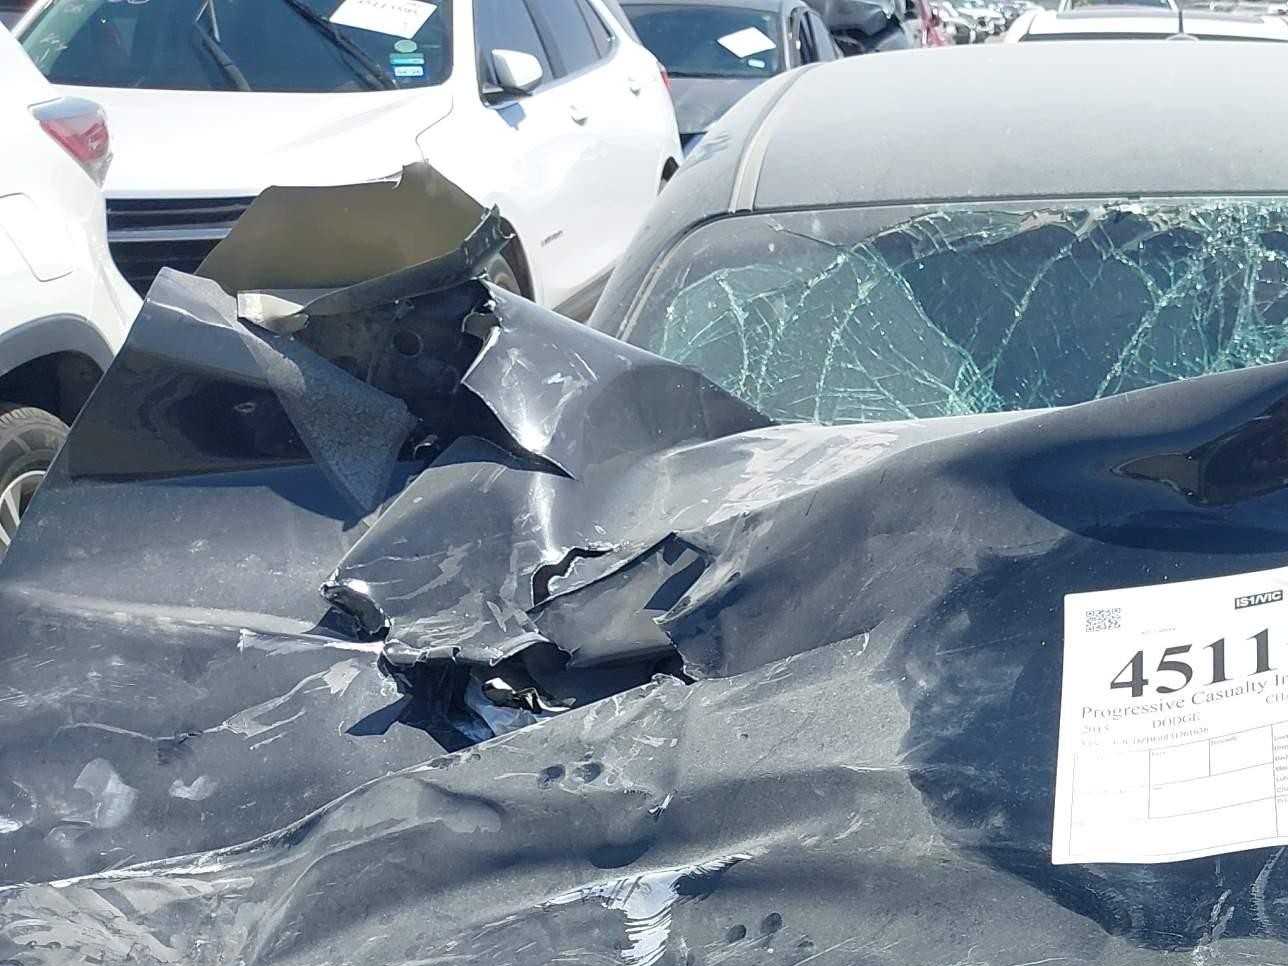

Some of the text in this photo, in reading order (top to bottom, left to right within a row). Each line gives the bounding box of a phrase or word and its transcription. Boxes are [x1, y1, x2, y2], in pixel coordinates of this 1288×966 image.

[1081, 698, 1185, 721] Progressive
[1191, 679, 1268, 705] Casualty
[1152, 712, 1201, 729] DODGE
